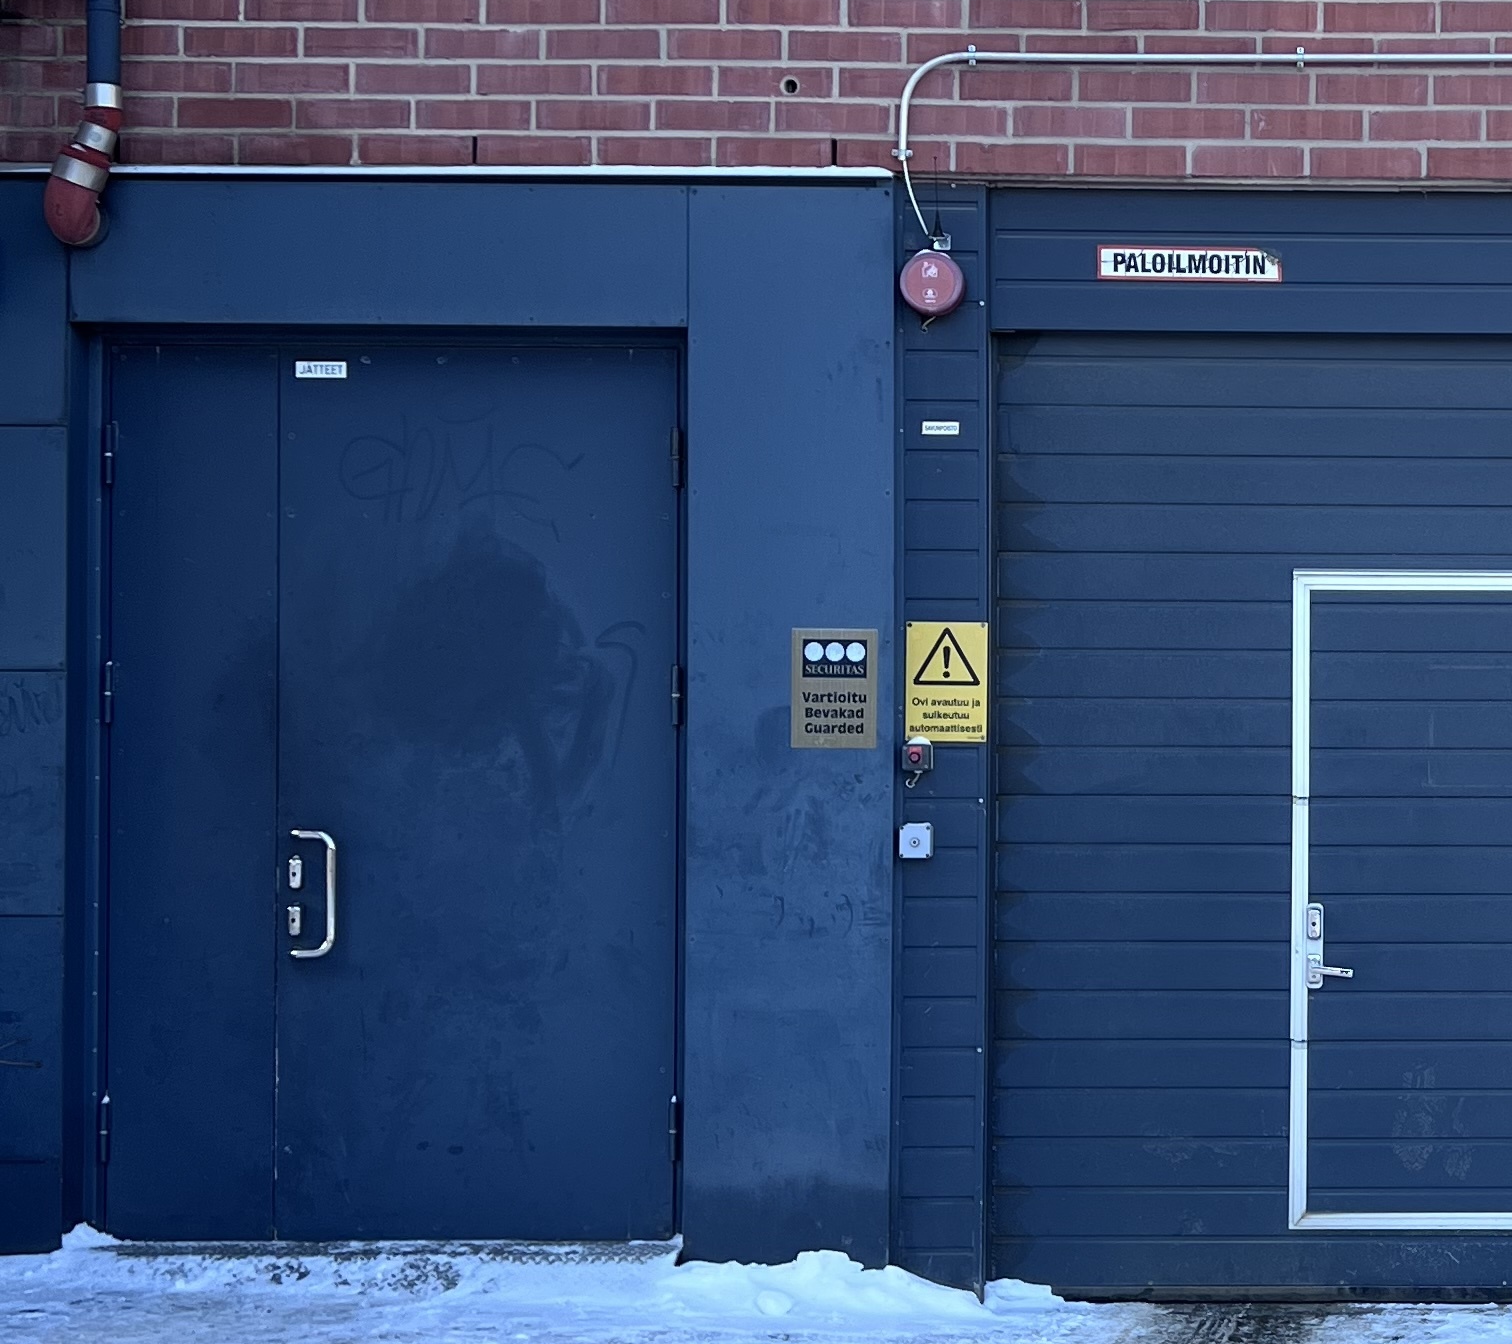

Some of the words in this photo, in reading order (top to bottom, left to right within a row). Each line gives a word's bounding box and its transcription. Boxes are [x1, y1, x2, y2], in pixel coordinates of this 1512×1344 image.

[1113, 252, 1266, 275] PALOILMOITIN
[805, 664, 864, 675] SECURITAS
[802, 691, 867, 704] Vartioitu
[912, 697, 928, 706] Ovi
[931, 698, 969, 707] avautuu
[972, 698, 981, 709] ja
[805, 707, 864, 719] Bevakad
[922, 711, 970, 720] sulkeutuu
[804, 722, 864, 734] Guarded
[909, 725, 983, 733] automaattisesti
